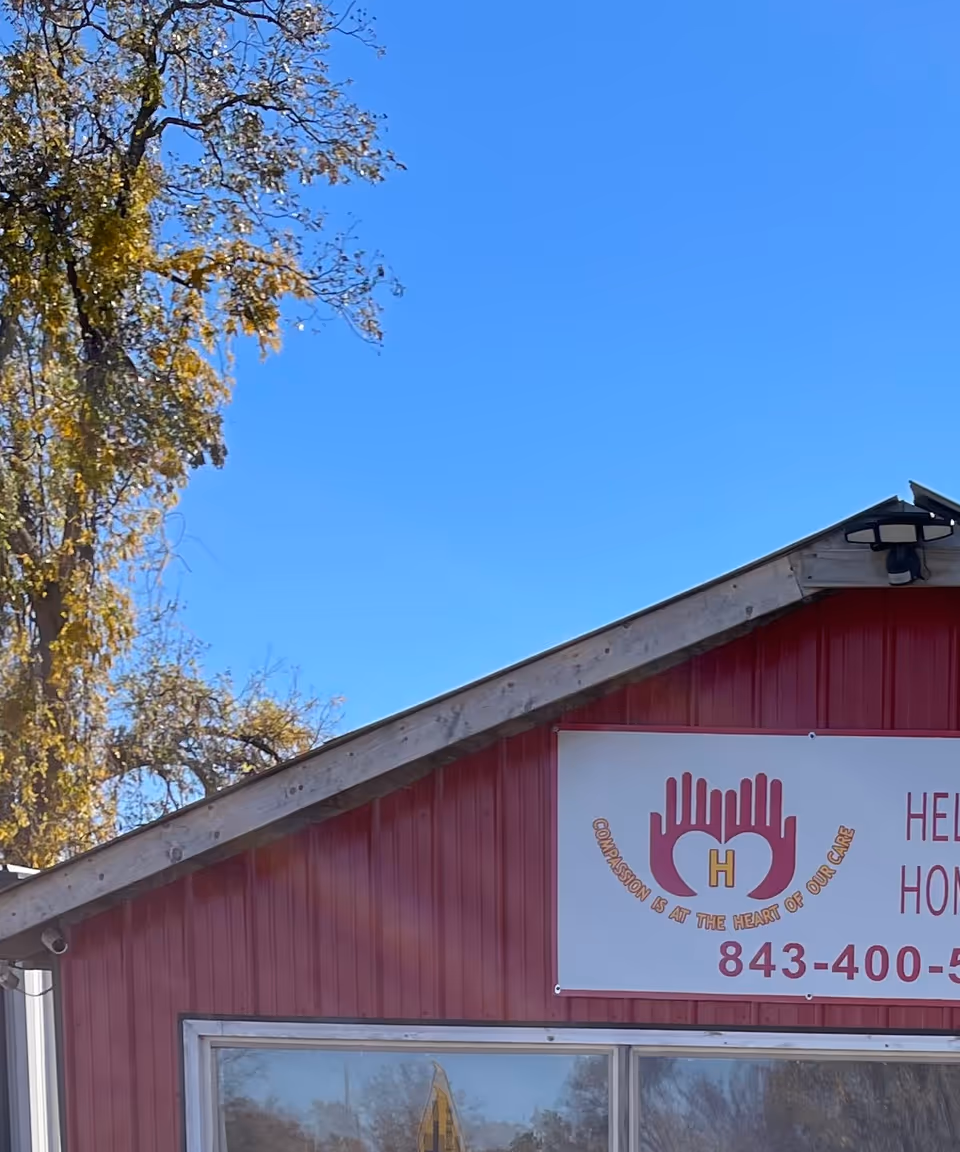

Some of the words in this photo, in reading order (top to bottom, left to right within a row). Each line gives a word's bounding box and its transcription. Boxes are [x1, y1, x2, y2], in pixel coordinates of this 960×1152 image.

[592, 818, 652, 902] COMPASSION
[651, 896, 668, 914] IS
[668, 905, 692, 924] AT
[696, 912, 726, 931] THE
[733, 904, 781, 931] HEART
[784, 891, 804, 914] OF
[806, 864, 837, 895] OUR
[827, 825, 856, 865] CARE
[708, 848, 736, 889] H
